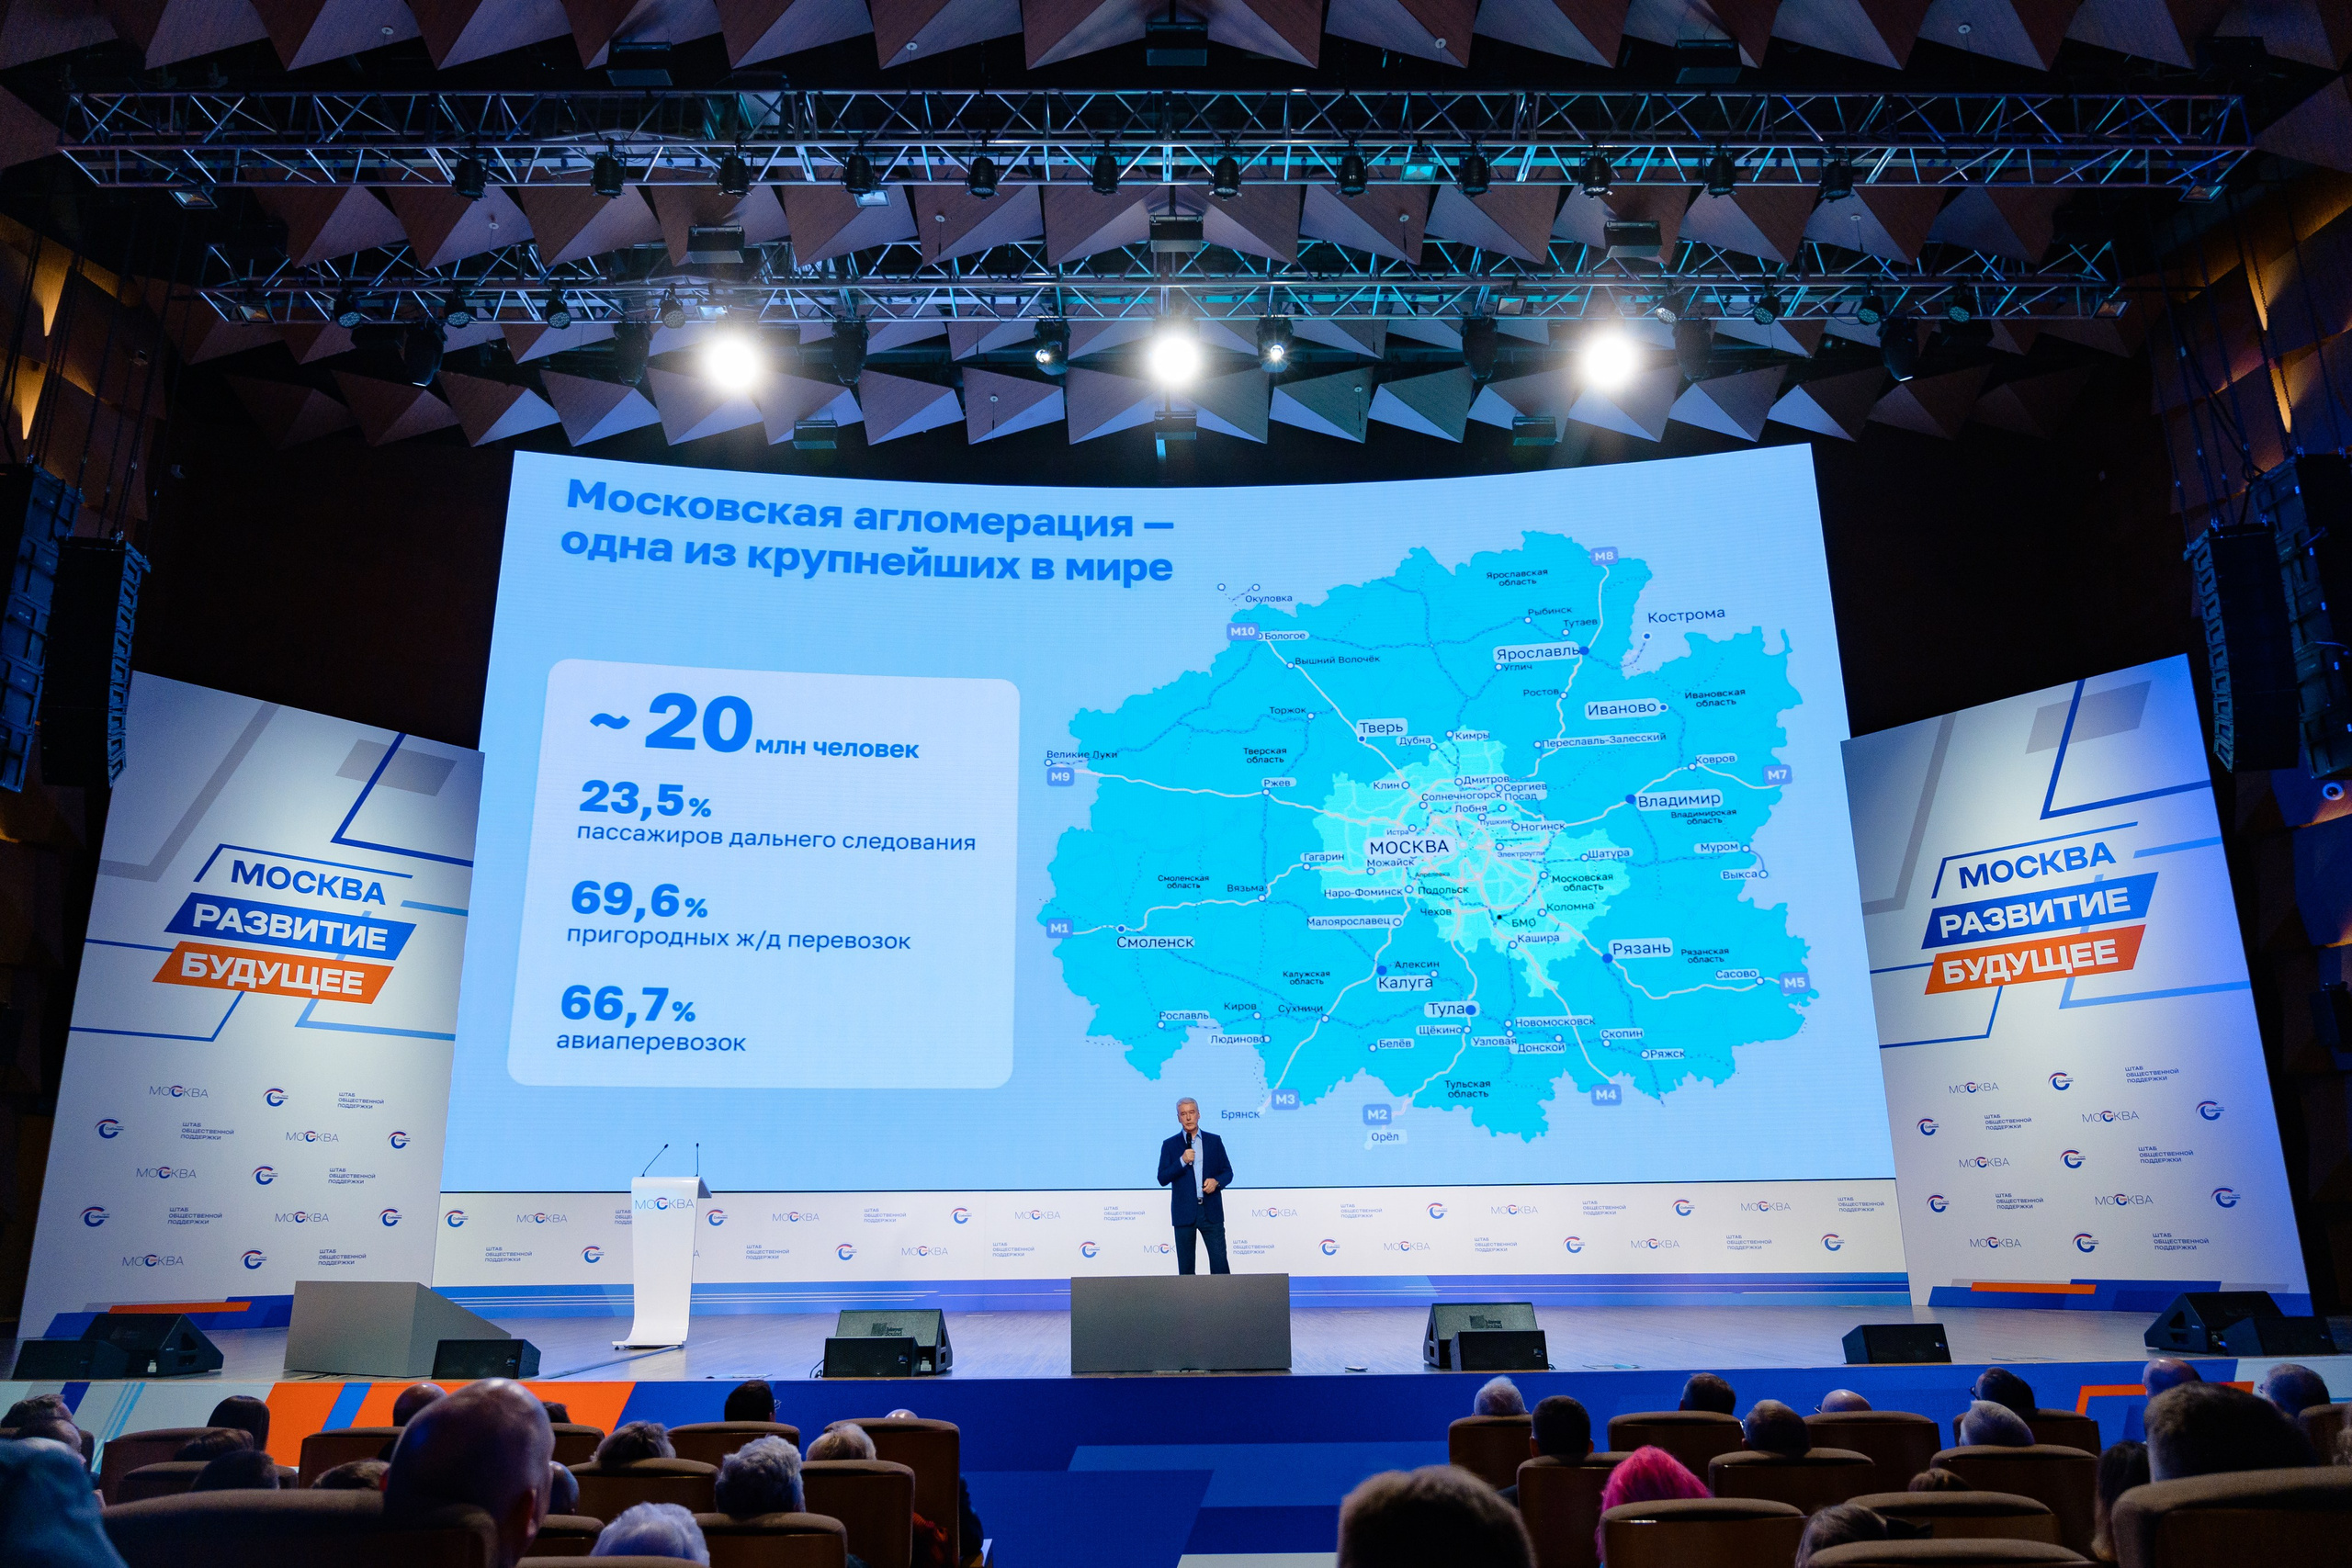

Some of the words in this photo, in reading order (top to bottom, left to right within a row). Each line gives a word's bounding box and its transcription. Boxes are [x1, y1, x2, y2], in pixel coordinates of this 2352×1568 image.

[566, 479, 842, 528] Московская
[854, 506, 1133, 542] агломерация
[560, 531, 673, 563] одна
[684, 541, 736, 567] из
[748, 543, 1020, 580] крупнейших
[1032, 558, 1055, 580] в
[1066, 558, 1173, 588] мире
[1595, 552, 1613, 560] М8
[1487, 570, 1548, 580] Ярославская
[1245, 593, 1293, 604] Окуловка
[1528, 606, 1572, 615] Рыбинск
[1648, 608, 1725, 625] Кострома
[1564, 618, 1598, 628] Тутаев
[1231, 626, 1255, 636] М10
[1265, 632, 1306, 641] Бологое
[1497, 646, 1580, 660] Ярославль
[1295, 656, 1335, 665] Вышний
[1339, 654, 1380, 664] Волочёк
[1504, 663, 1532, 671] Углич
[1685, 689, 1746, 699] Ивановская
[1696, 698, 1736, 707] область
[1270, 706, 1306, 715] Торжок
[1588, 702, 1657, 716] Иваново
[645, 692, 753, 752] 20
[755, 739, 806, 755] млн
[813, 739, 920, 759] человек
[1359, 723, 1403, 735] Тверь
[1455, 732, 1489, 740] Кимры
[1542, 733, 1667, 748] Переславль-Залесский
[1399, 738, 1430, 746] Дубна
[1046, 750, 1090, 759] Великие
[1696, 755, 1735, 765] Ковров
[1051, 773, 1070, 781] М9
[1768, 770, 1787, 779] М7
[1263, 779, 1291, 787] Ржев
[1464, 775, 1510, 785] Дмитров
[1504, 784, 1547, 793] Сергиев
[1422, 792, 1501, 802] Солнечногорск
[1639, 793, 1721, 808] Владимир
[1671, 809, 1736, 818] Владимирская
[1687, 817, 1723, 825] область
[1521, 823, 1566, 831] Ногинск
[577, 825, 723, 847] пассажиров
[729, 829, 835, 849] дальнего
[842, 833, 976, 852] следования
[1370, 840, 1449, 854] МОСКВА
[1701, 843, 1738, 852] Муром
[1304, 853, 1344, 862] Гагарин
[1589, 849, 1630, 859] Шатура
[1367, 858, 1414, 866] Можайск
[1959, 842, 2117, 889] МОСКВА
[1552, 874, 1613, 883] Московская
[1723, 871, 1758, 879] Выкса
[231, 860, 386, 905] МОСКВА
[1227, 885, 1264, 893] Вязьма
[1324, 889, 1403, 897] Наро-Фоминск
[1419, 886, 1468, 895] Подольск
[1564, 884, 1603, 892] область
[1547, 903, 1594, 911] Коломна
[1939, 887, 2131, 938] РАЗВИТИЕ
[193, 903, 388, 951] РАЗВИТИЕ
[1306, 918, 1390, 926] Малоярославец
[1512, 919, 1536, 927] БМО
[1051, 924, 1069, 932] М1
[567, 926, 729, 947] пригородных
[736, 930, 781, 951] ж/д
[788, 932, 910, 952] перевозок
[1116, 936, 1194, 948] Смоленск
[1518, 934, 1559, 942] Кашира
[1612, 942, 1671, 954] Рязань
[1681, 948, 1729, 956] Рязанская
[1395, 960, 1440, 968] Алексин
[1942, 939, 2119, 984] БУДУЩЕЕ
[181, 952, 365, 995] БУДУЩЕЕ
[1715, 970, 1757, 978] Сасово
[1379, 976, 1433, 990] Калуга
[1784, 978, 1805, 987] М5
[1224, 1002, 1257, 1010] Киров
[1429, 1002, 1465, 1017] Тула
[1159, 1011, 1209, 1020] Рославль
[1516, 1017, 1595, 1027] Новомосковск
[1419, 1025, 1462, 1035] Щёкино
[1601, 1030, 1643, 1038] Скопин
[557, 1033, 746, 1054] авиаперевозок
[1211, 1035, 1264, 1044] Людиново
[1379, 1039, 1411, 1048] Белёв
[1473, 1037, 1517, 1045] Узловая
[1518, 1043, 1566, 1052] Донской
[1650, 1050, 1685, 1058] Ряжск
[2126, 1068, 2179, 1077] ОБЩЕСТВЕННОЙ
[1445, 1080, 1490, 1089] Тульская
[1949, 1082, 1999, 1094] МОСКВА
[150, 1086, 209, 1098] МОСКВА
[1448, 1089, 1488, 1098] область
[1596, 1089, 1616, 1100] М4
[1276, 1095, 1295, 1104] М3
[1221, 1111, 1260, 1120] Брянск
[1368, 1111, 1387, 1120] М2
[2082, 1111, 2139, 1122] МОСКВА
[286, 1131, 339, 1142] МОСКВА
[1372, 1133, 1399, 1142] Орёл
[1959, 1156, 2010, 1168] МОСКВА
[137, 1167, 196, 1179] МОСКВА
[635, 1198, 694, 1210] МОСКВА
[2095, 1194, 2154, 1206] МОСКВА
[1491, 1204, 1538, 1214] МОСКВА
[1741, 1201, 1791, 1212] МОСКВА
[276, 1212, 329, 1223] МОСКВА
[773, 1212, 820, 1223] МОСКВА
[1015, 1210, 1060, 1220] МОСКВА
[1252, 1208, 1297, 1218] МОСКВА
[516, 1213, 567, 1224] МОСКВА
[1384, 1241, 1430, 1251] МОСКВА
[1631, 1238, 1679, 1249] МОСКВА
[1970, 1237, 2021, 1248] МОСКВА
[901, 1246, 948, 1257] МОСКВА
[1144, 1244, 1175, 1254] МОСК
[122, 1255, 184, 1267] МОСКВА
